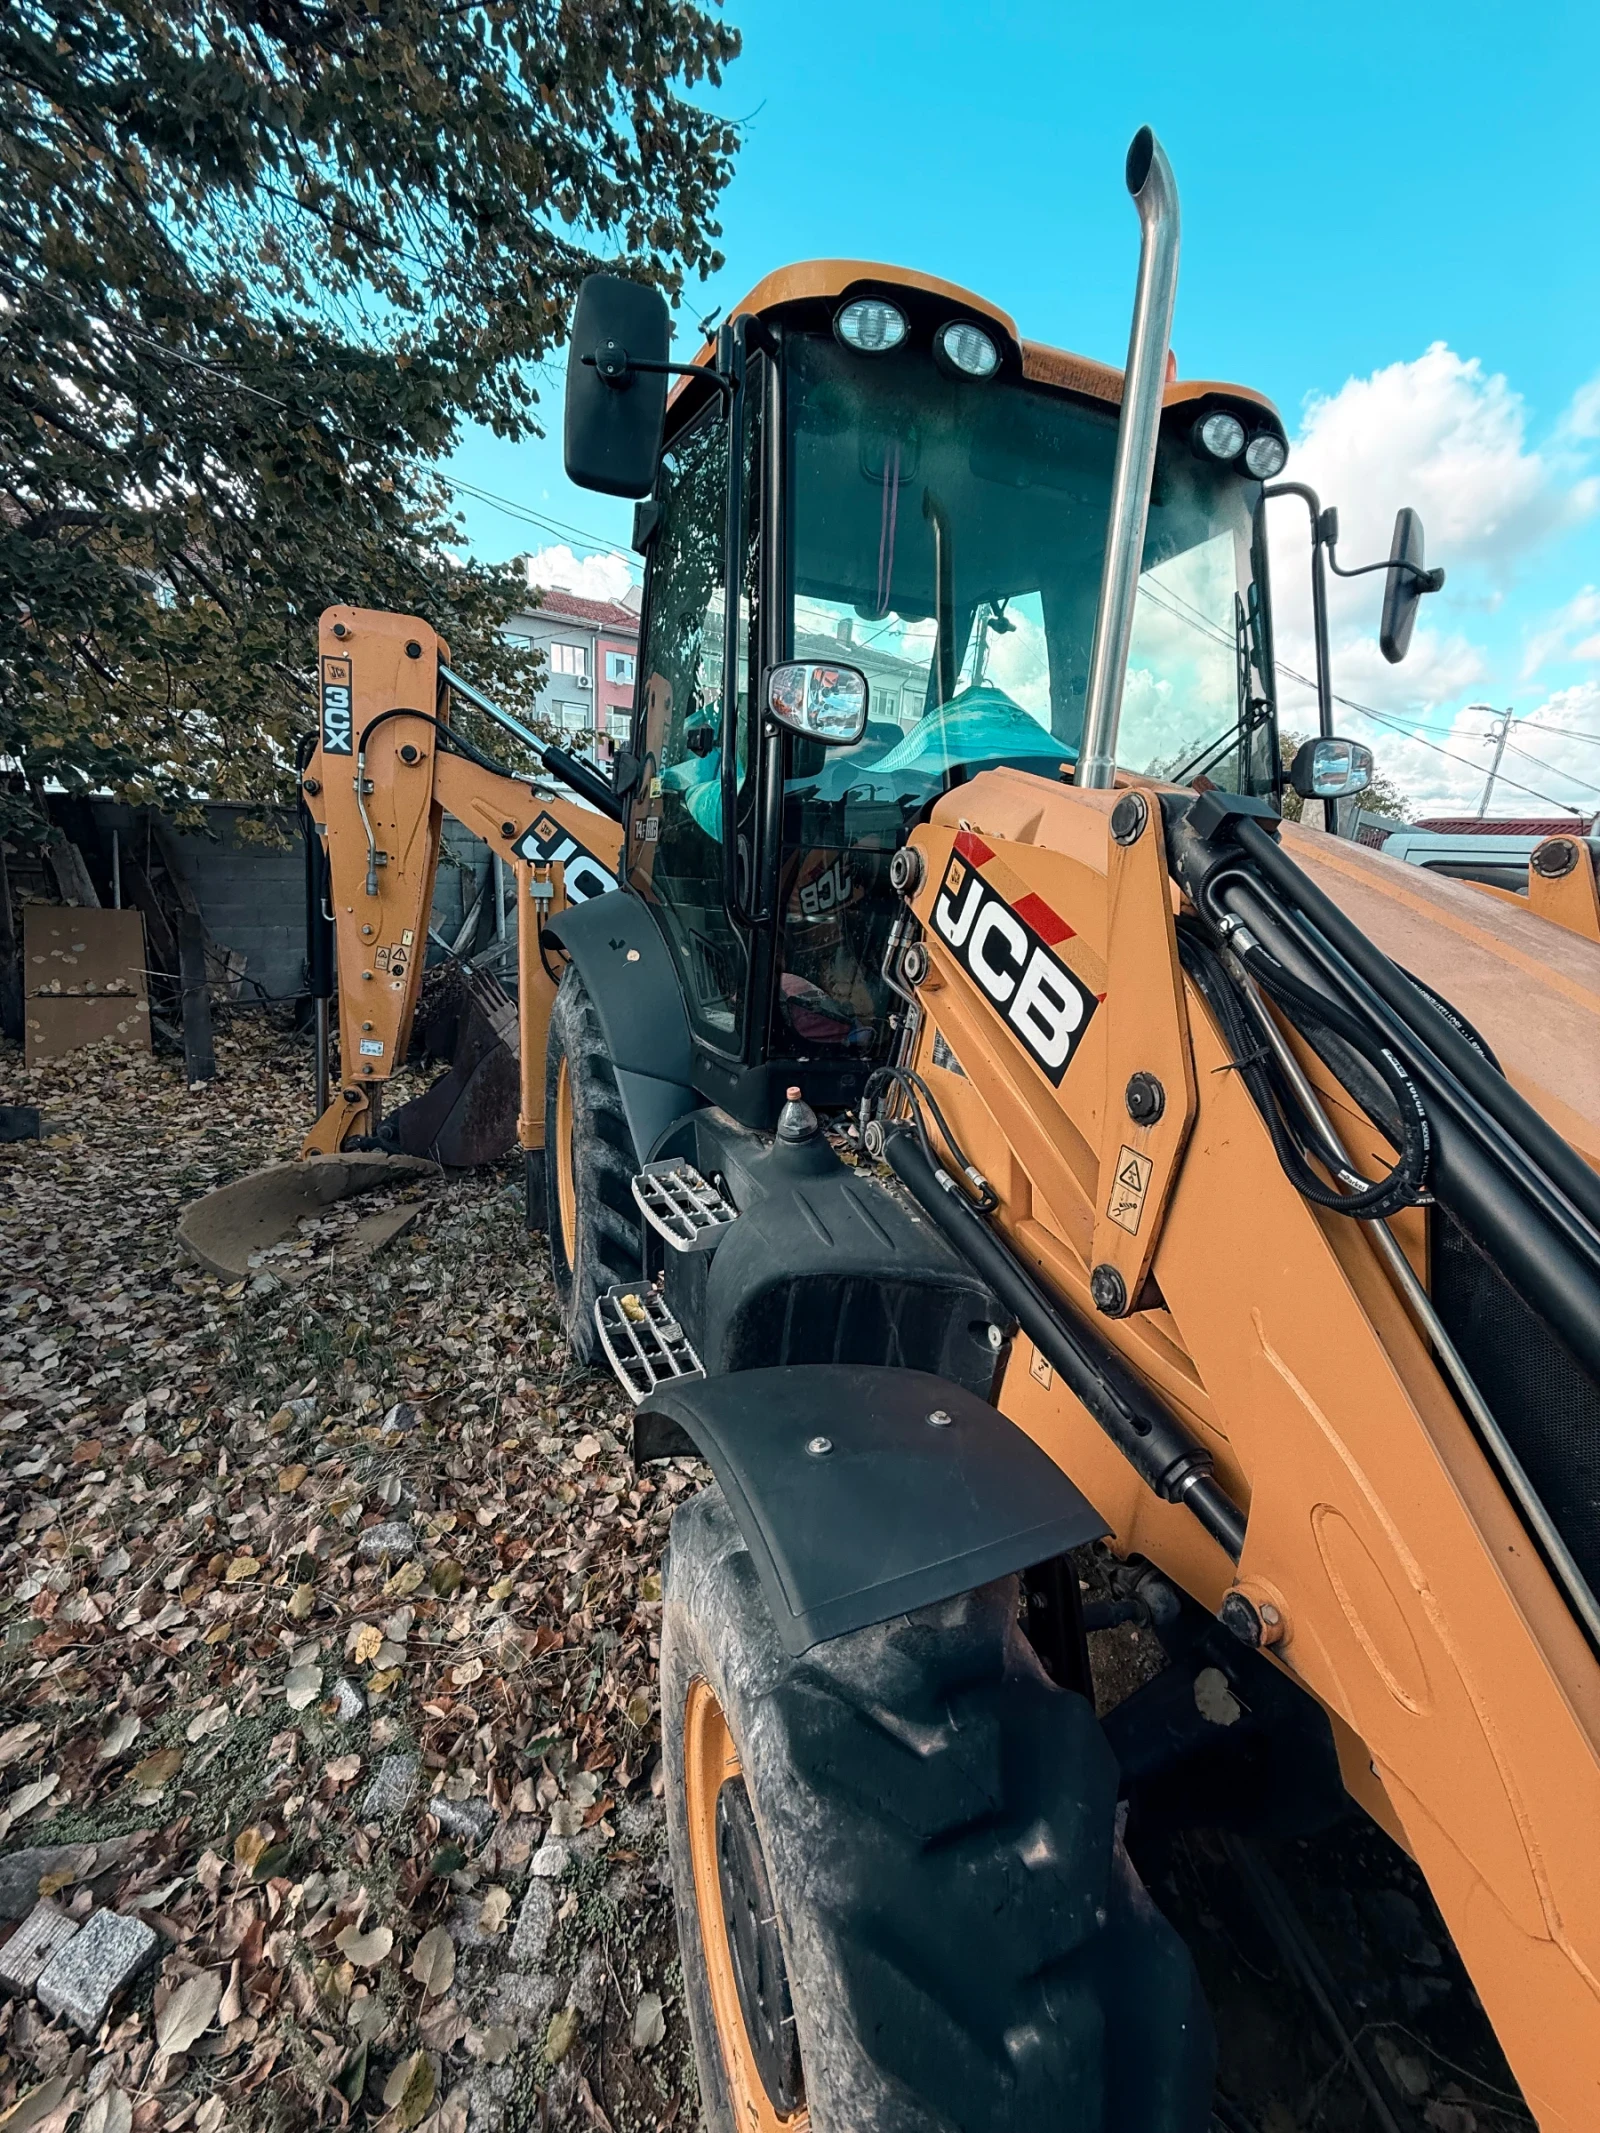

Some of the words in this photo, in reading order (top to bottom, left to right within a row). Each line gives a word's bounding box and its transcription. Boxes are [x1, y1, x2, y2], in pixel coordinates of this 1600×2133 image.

[324, 686, 351, 751] 3CX
[521, 834, 619, 904] JC
[935, 877, 1084, 1068] JCB
[1405, 1080, 1426, 1117] TOUGH
[1420, 1119, 1430, 1151] COVER
[1343, 1172, 1367, 1191] Parker
